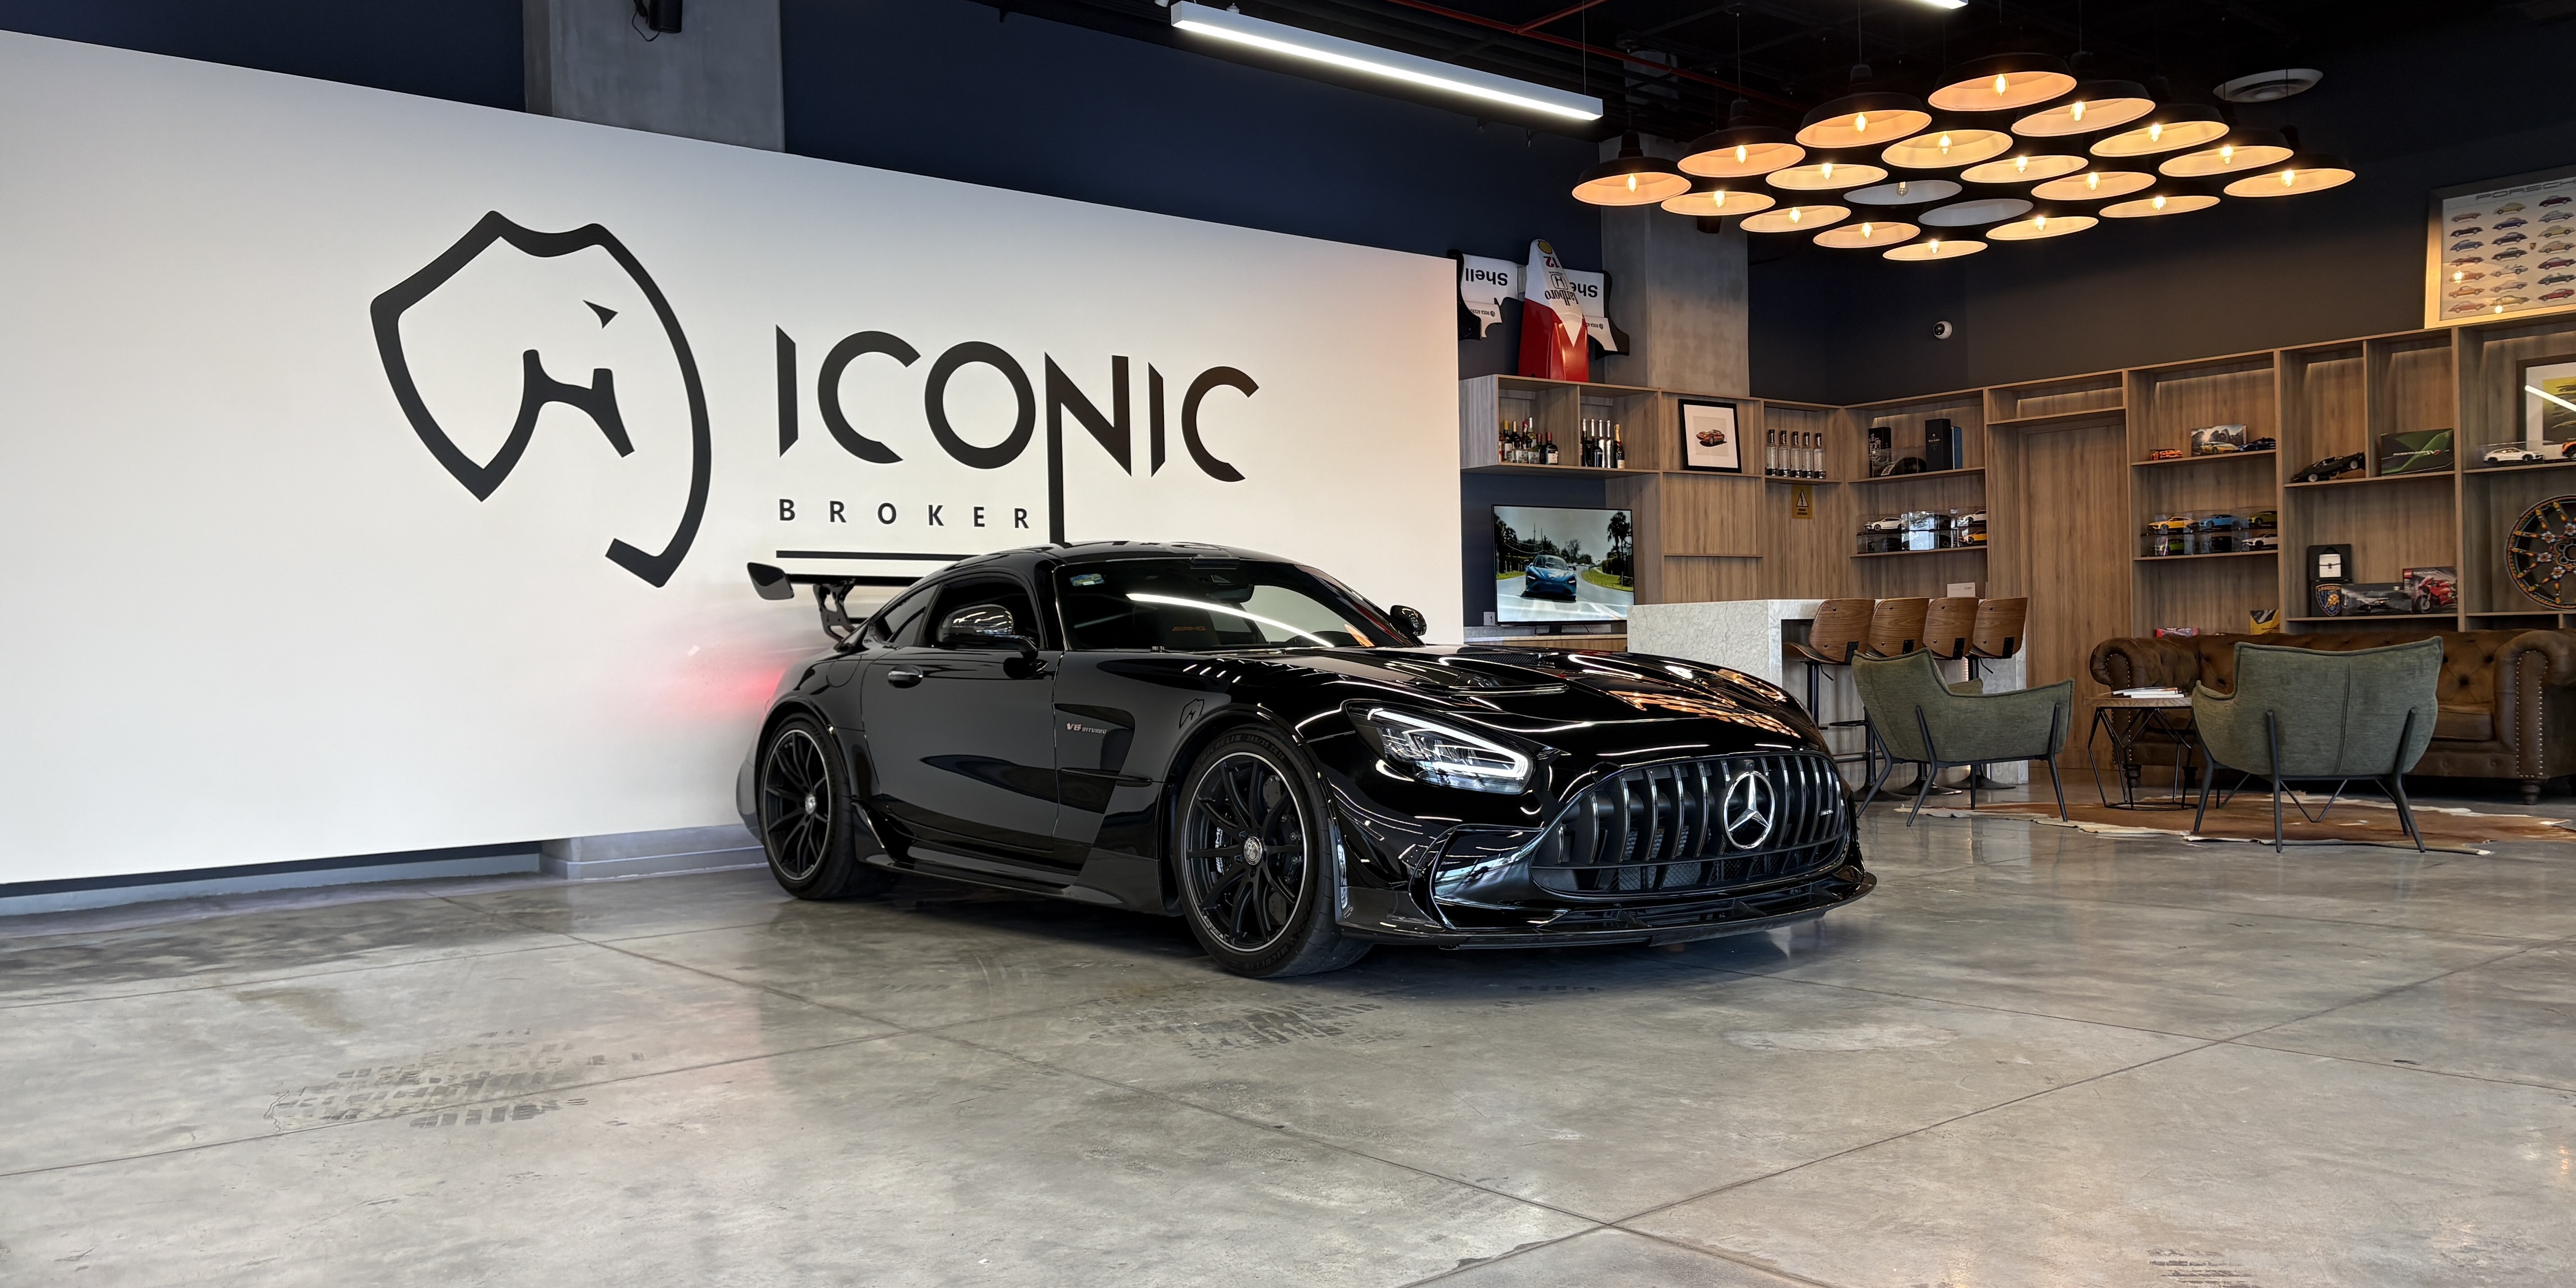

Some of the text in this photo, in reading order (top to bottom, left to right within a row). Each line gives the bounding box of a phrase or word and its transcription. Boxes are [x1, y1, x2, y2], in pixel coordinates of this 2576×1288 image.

[2476, 178, 2576, 200] PORSCH
[1543, 256, 1560, 268] 12
[1466, 268, 1508, 286] Shell
[1569, 282, 1598, 298] She
[775, 324, 1259, 544] ICONIC
[779, 498, 1029, 529] BROKER
[1067, 723, 1082, 731] V8
[1200, 734, 1242, 764] MICHELIN
